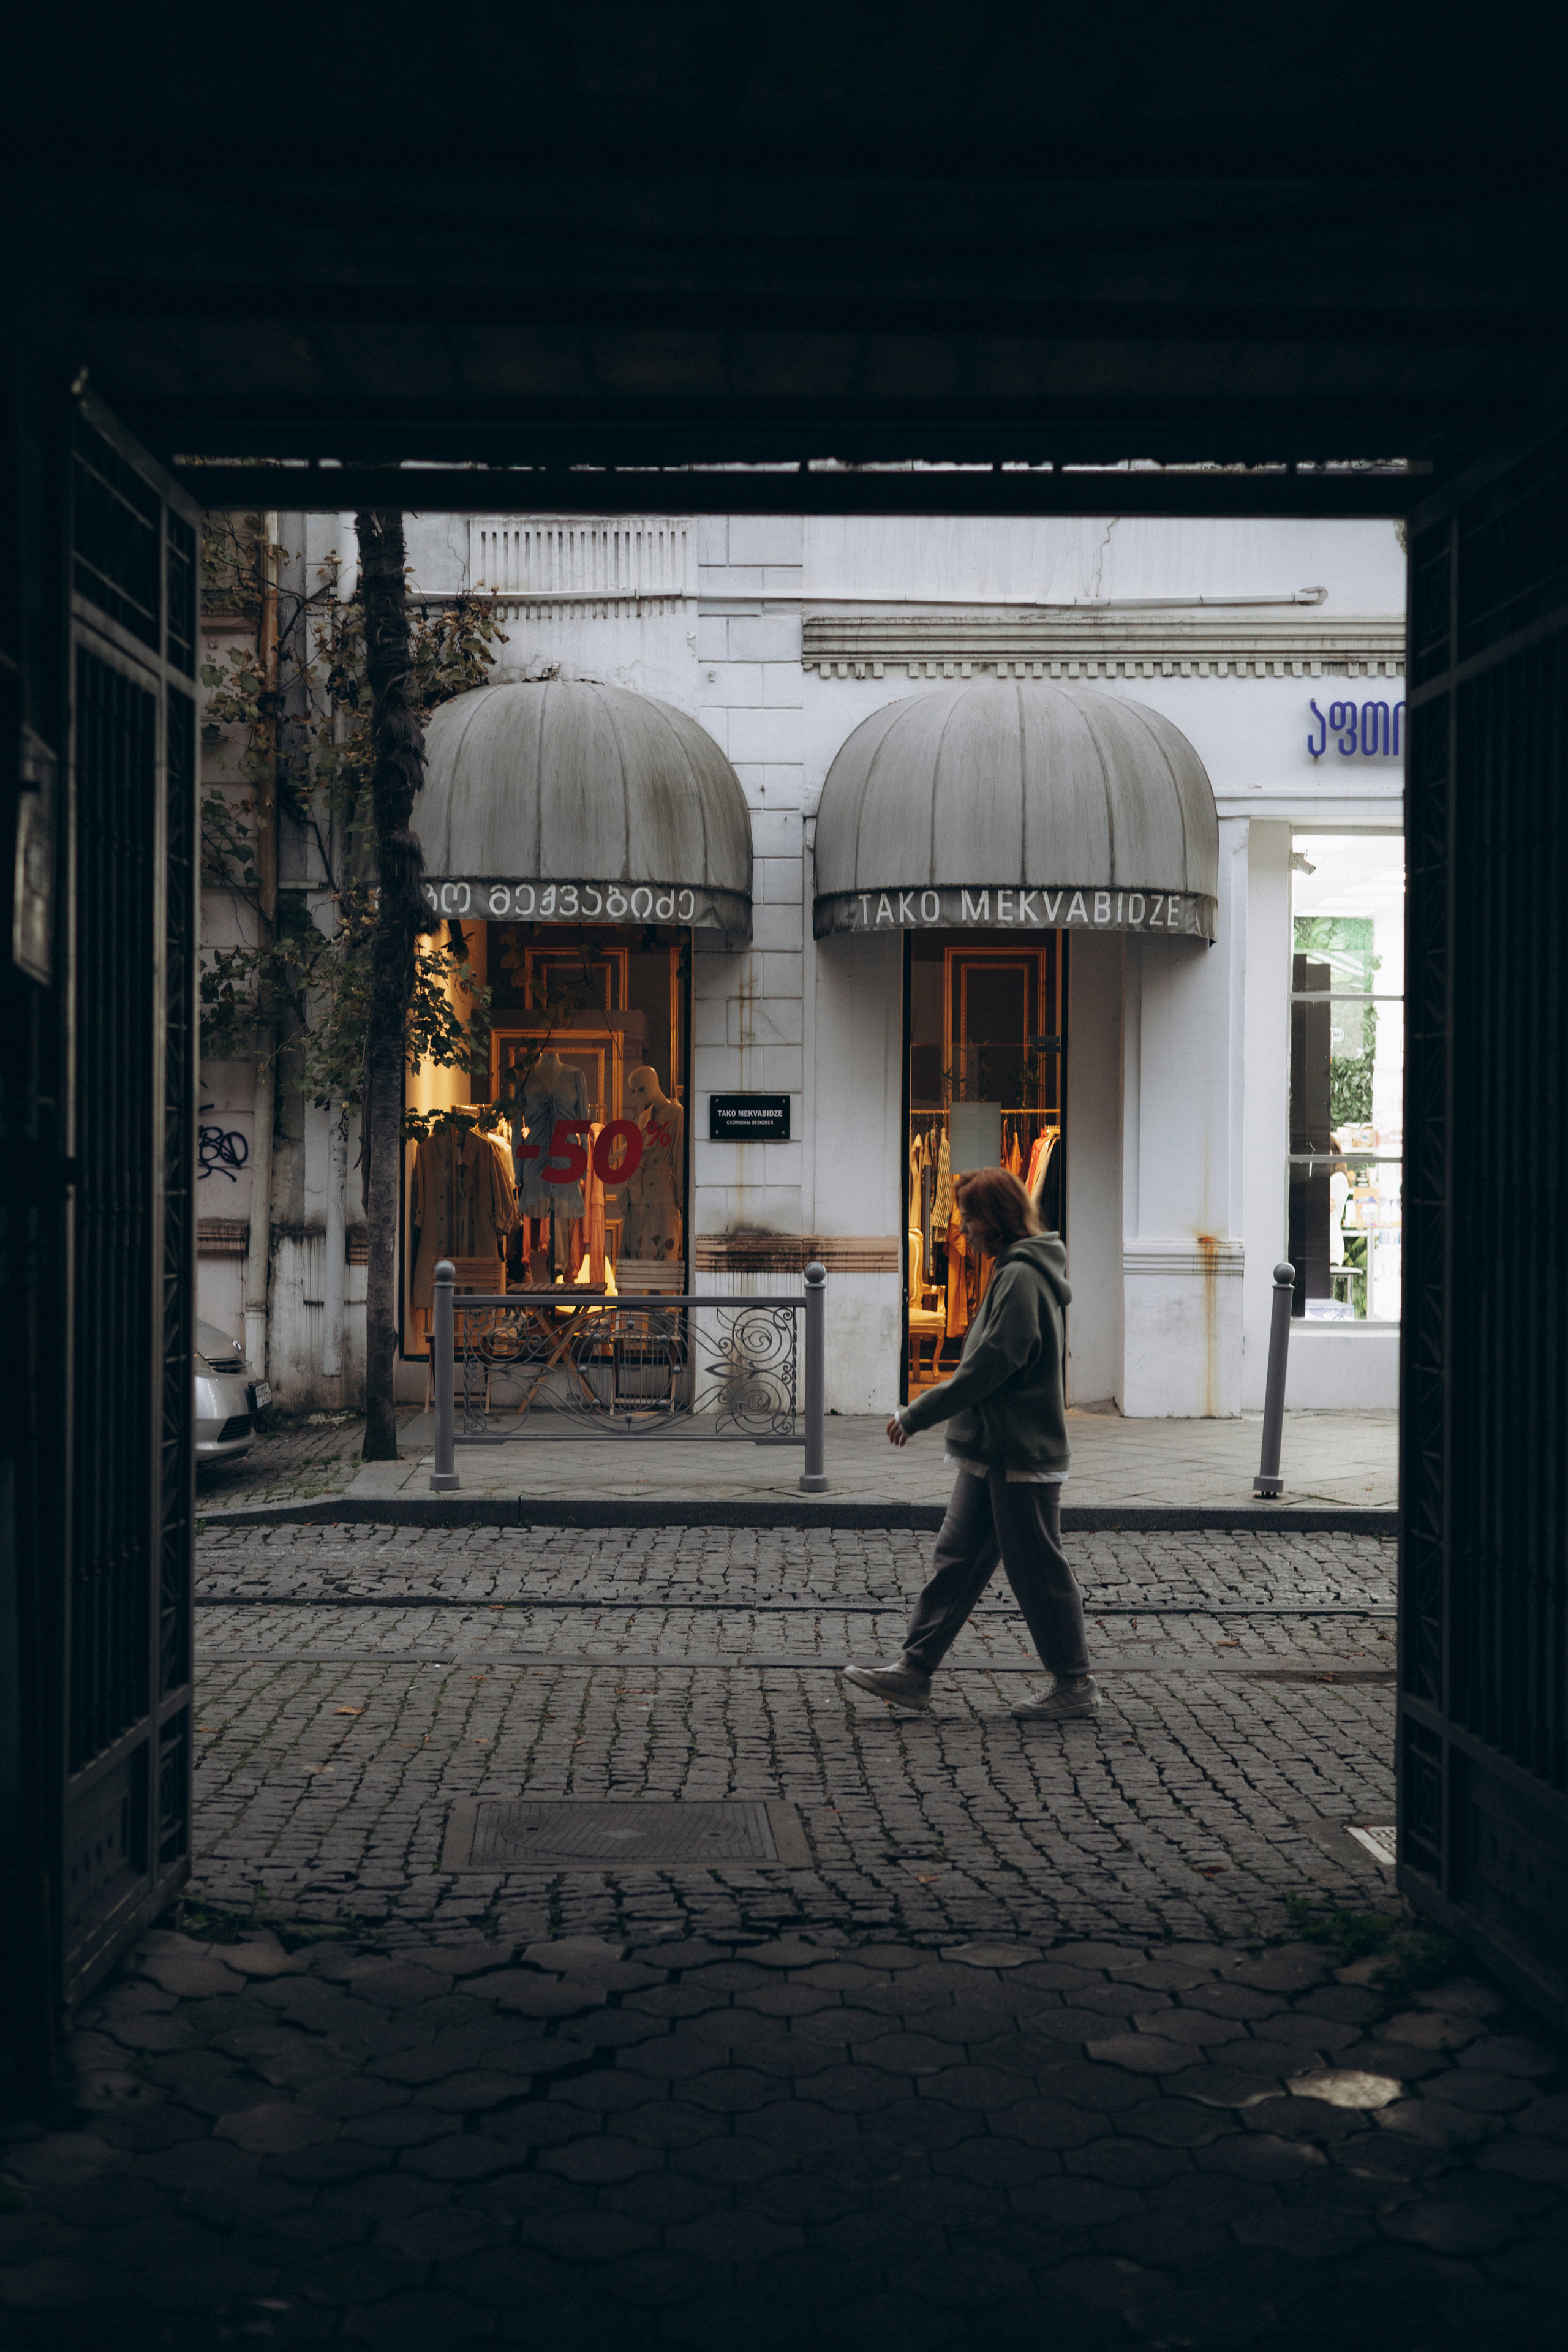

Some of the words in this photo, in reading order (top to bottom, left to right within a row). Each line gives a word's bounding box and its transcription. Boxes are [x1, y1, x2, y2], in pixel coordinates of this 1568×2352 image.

[489, 884, 695, 920] მექვაბიძე
[858, 889, 940, 924] TAKO
[960, 889, 1180, 926] MEKVABIDZE
[515, 1119, 671, 1185] -50%
